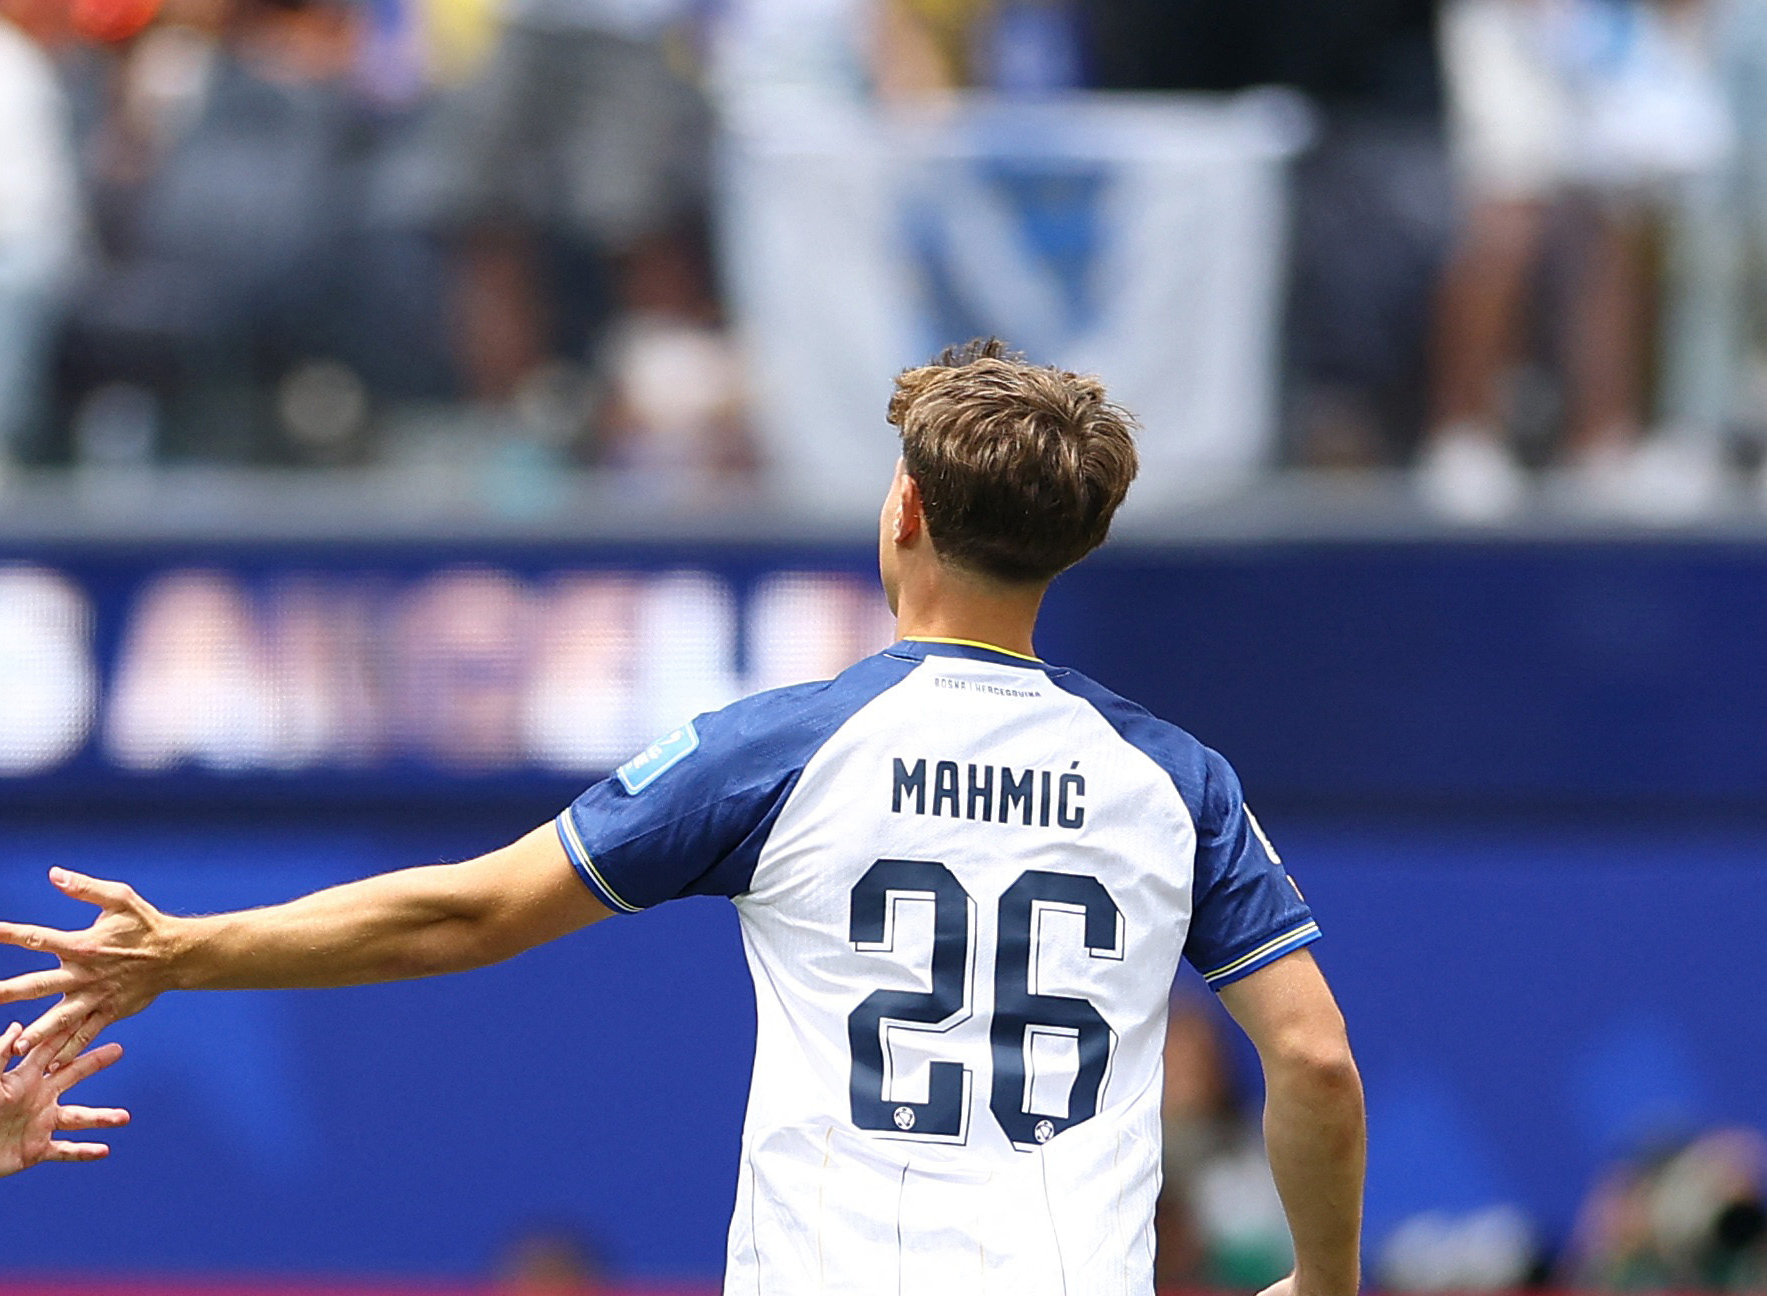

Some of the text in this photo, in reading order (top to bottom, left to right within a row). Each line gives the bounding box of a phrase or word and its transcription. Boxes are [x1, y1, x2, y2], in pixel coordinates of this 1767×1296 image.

[102, 560, 894, 778] ANGELE
[891, 757, 1086, 830] MAHMIĆ
[848, 858, 1125, 1153] 26
